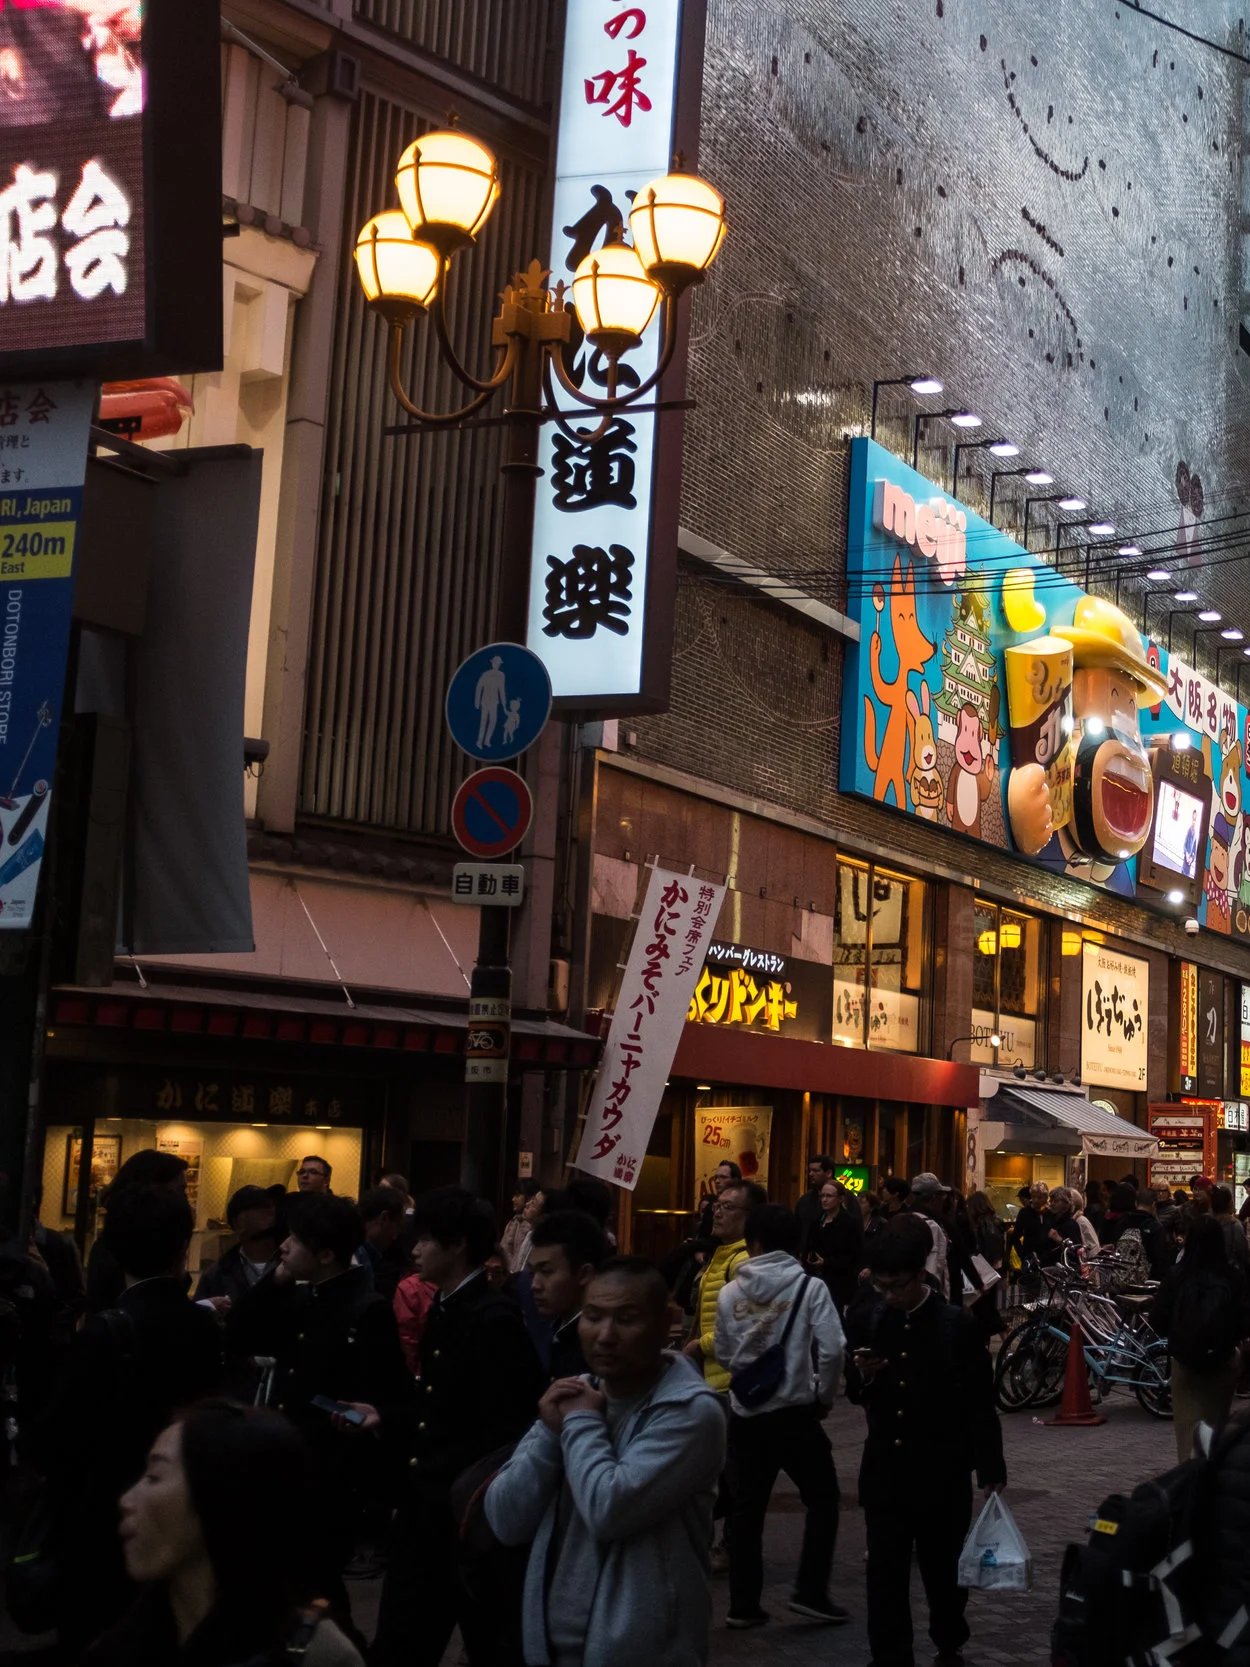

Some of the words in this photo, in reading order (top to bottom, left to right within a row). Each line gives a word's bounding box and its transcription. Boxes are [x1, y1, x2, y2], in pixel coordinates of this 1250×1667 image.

[2, 532, 66, 558] 240m
[875, 479, 967, 586] meiji
[1, 561, 26, 574] East
[1, 589, 22, 688] DOTONBORI
[455, 873, 520, 896] 自動車
[675, 885, 716, 976] 特別会席フェア
[708, 945, 785, 972] ハンバーグレストラン
[590, 879, 689, 1160] かにみそバーニャカウダ
[468, 1065, 492, 1075] 阪市
